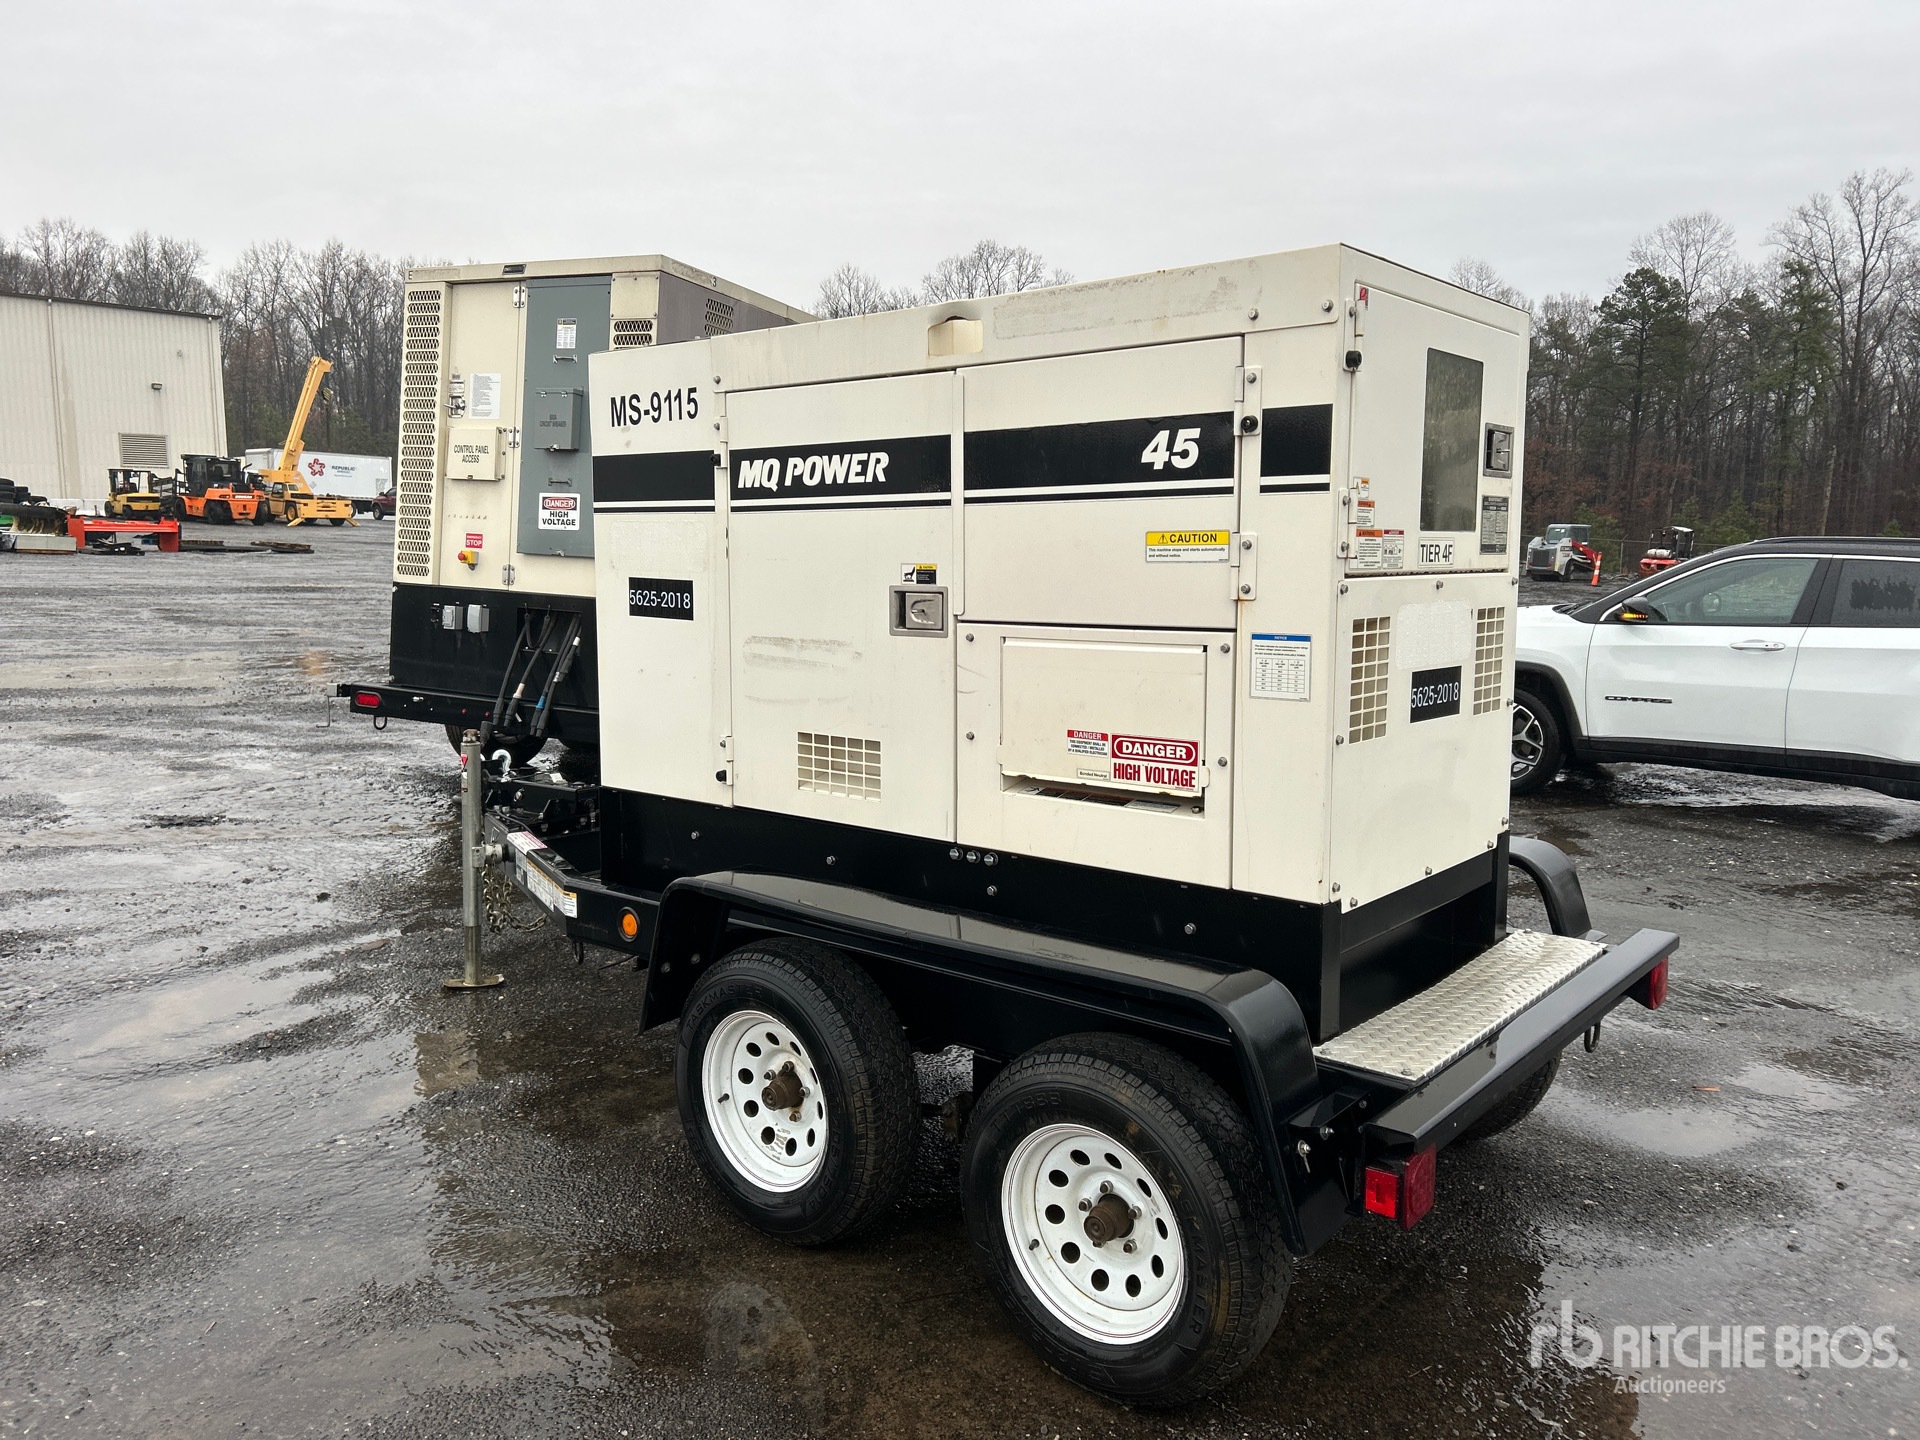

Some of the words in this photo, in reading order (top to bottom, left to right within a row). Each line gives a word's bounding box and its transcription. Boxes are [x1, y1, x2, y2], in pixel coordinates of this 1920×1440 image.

[610, 387, 698, 427] MS-9115
[453, 444, 474, 454] CONTROL
[475, 445, 489, 454] PANEL
[1141, 428, 1201, 470] 45
[462, 454, 479, 463] ACCESS
[737, 457, 781, 492] MQ
[784, 451, 890, 487] POWER
[545, 499, 574, 508] DANGER
[542, 518, 576, 526] VOLTAGE
[549, 510, 569, 518] HIGH
[466, 539, 482, 547] STOP
[1169, 532, 1217, 544] CAUTION
[1420, 544, 1441, 563] TIER
[1442, 543, 1453, 563] 4F
[629, 590, 691, 609] 5625-2018
[1411, 682, 1459, 708] 5625-2018
[1073, 731, 1102, 740] DANGER
[1122, 741, 1187, 759] DANGER
[1113, 762, 1141, 781] HIGH
[1145, 765, 1196, 788] VOLTAGE
[685, 982, 763, 1031] TASKMASTER
